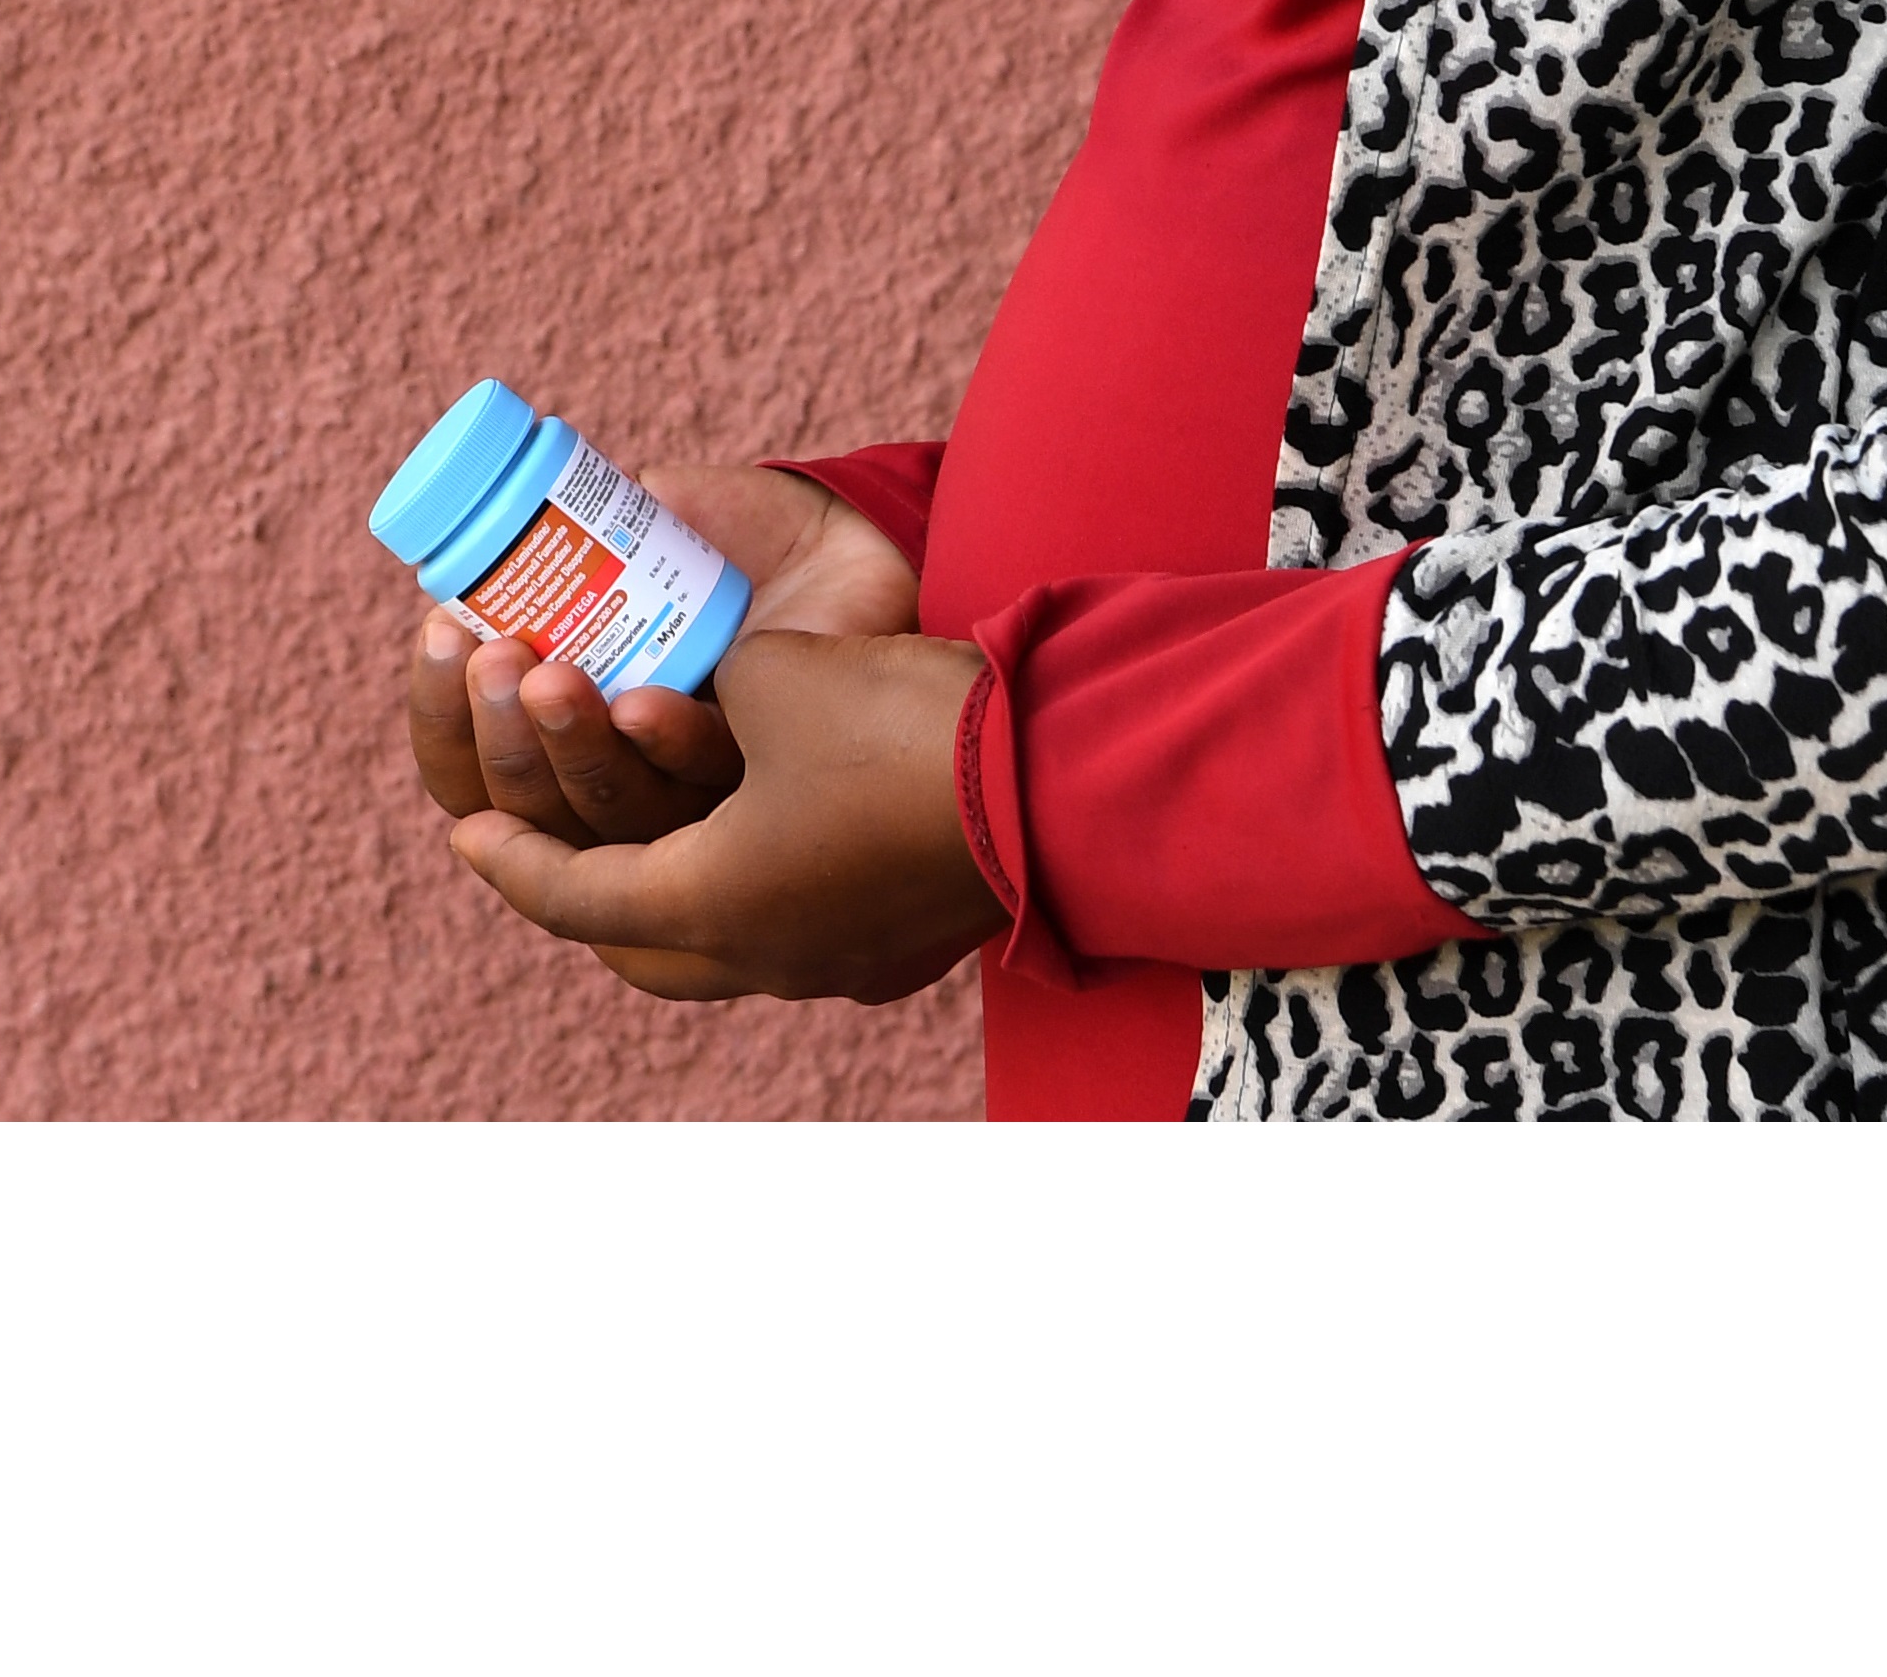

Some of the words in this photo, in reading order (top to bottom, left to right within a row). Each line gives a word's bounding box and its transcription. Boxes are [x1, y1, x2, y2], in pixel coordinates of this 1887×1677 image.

[506, 558, 541, 595] Disoproxil
[536, 524, 568, 562] Fumarate
[560, 536, 594, 577] Disoproxil
[527, 572, 587, 633] Tablets/Comprimés
[548, 590, 598, 644] ACRIPTEGA
[610, 595, 624, 609] mg
[656, 610, 687, 646] Mylan
[591, 617, 648, 679] Tablets/Comprimés
